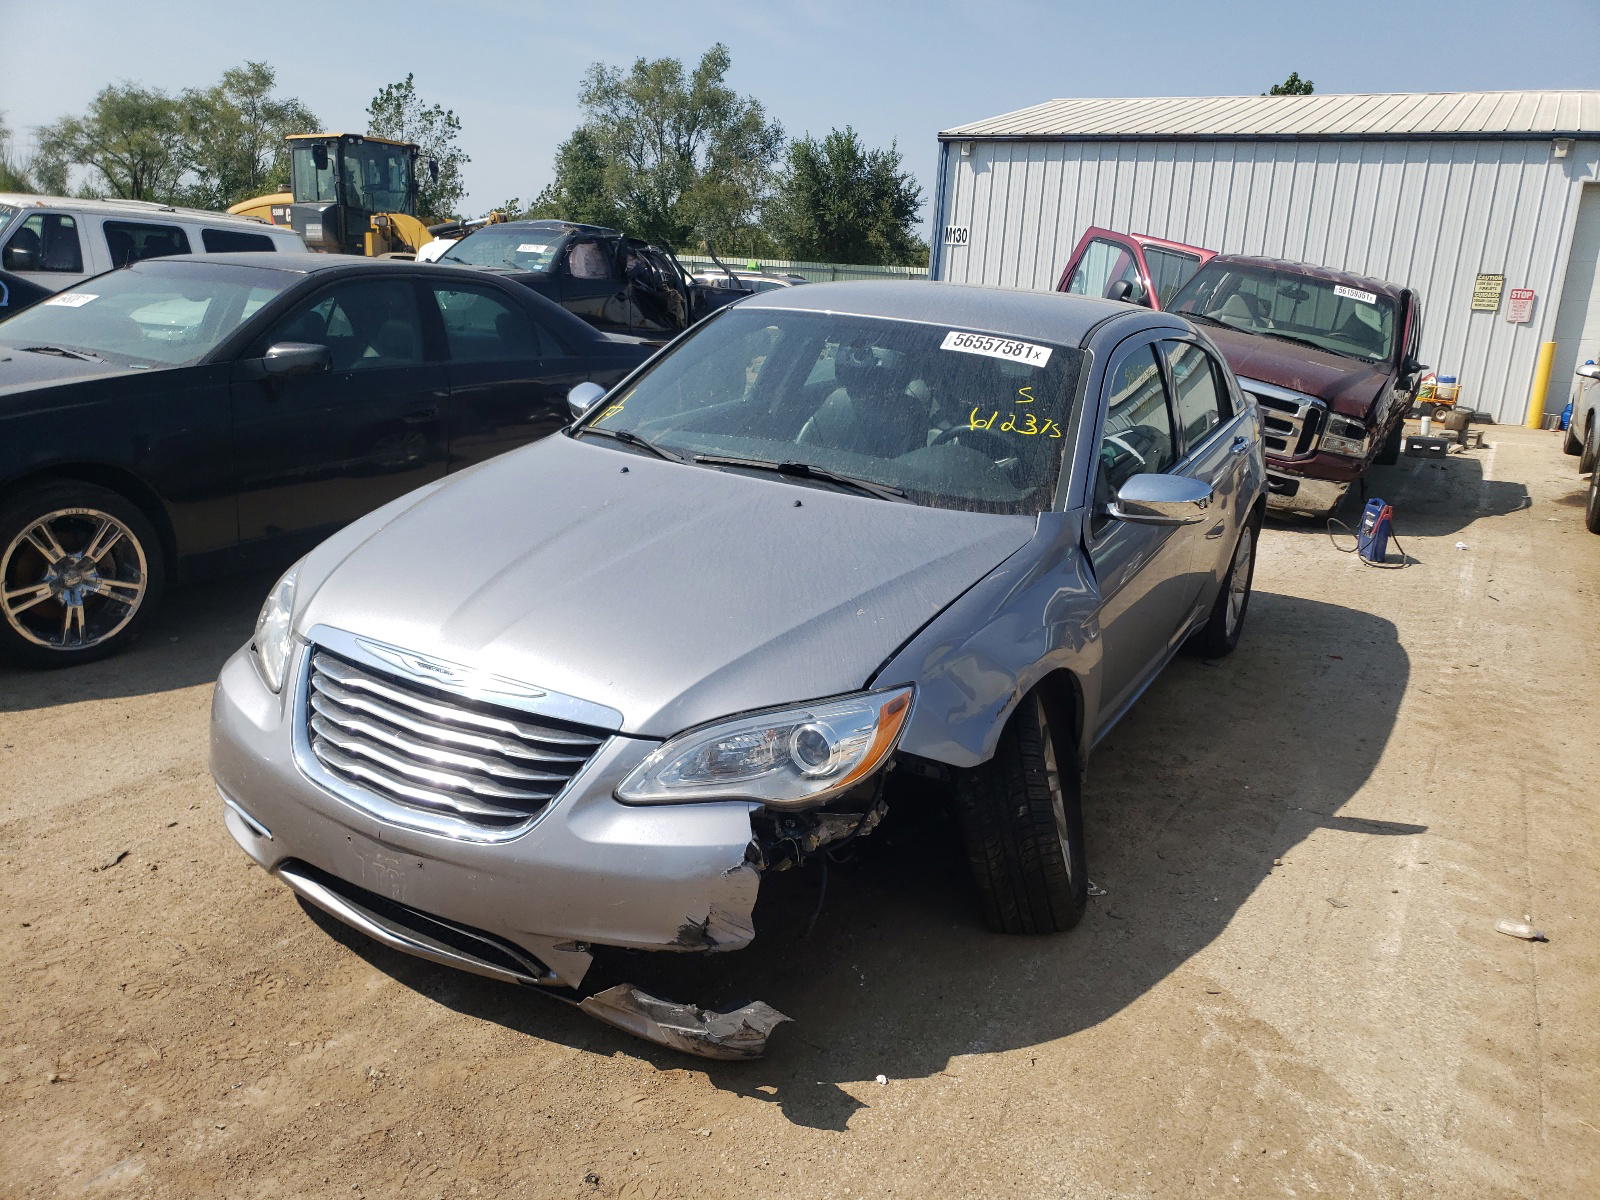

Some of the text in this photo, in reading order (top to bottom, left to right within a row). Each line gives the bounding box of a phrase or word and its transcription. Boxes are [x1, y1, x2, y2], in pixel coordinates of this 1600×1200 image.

[286, 208, 292, 222] C
[945, 226, 968, 244] M130
[1511, 291, 1532, 299] STOP
